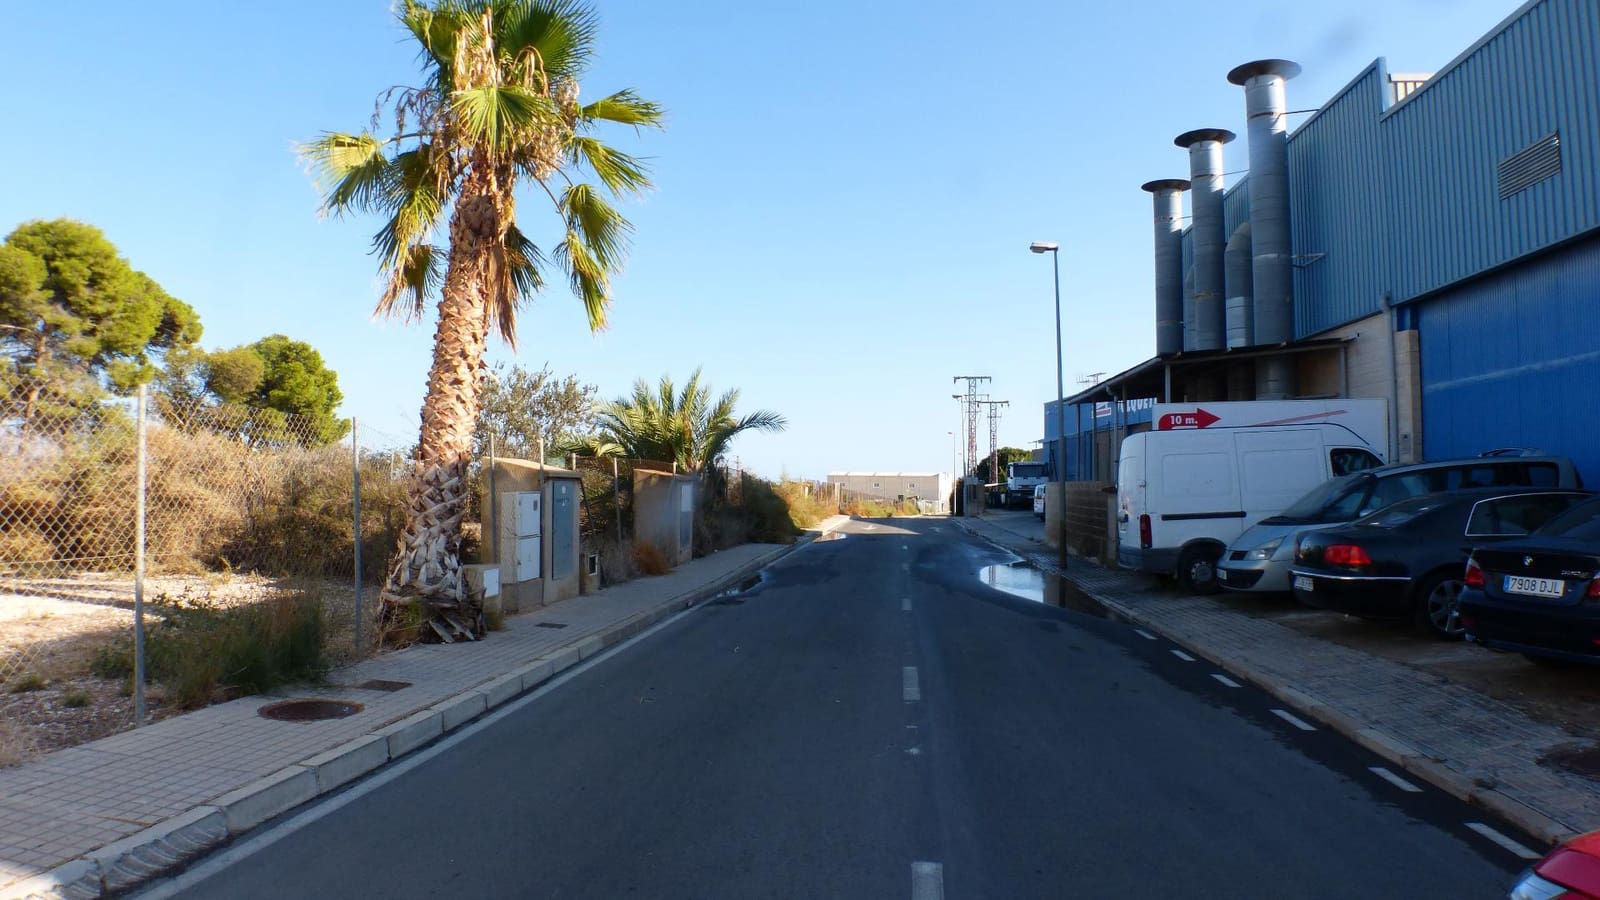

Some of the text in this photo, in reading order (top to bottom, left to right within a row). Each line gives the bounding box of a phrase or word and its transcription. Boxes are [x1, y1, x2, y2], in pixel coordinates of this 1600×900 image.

[1170, 415, 1182, 425] 10
[1510, 577, 1560, 594] 7908 DJL
